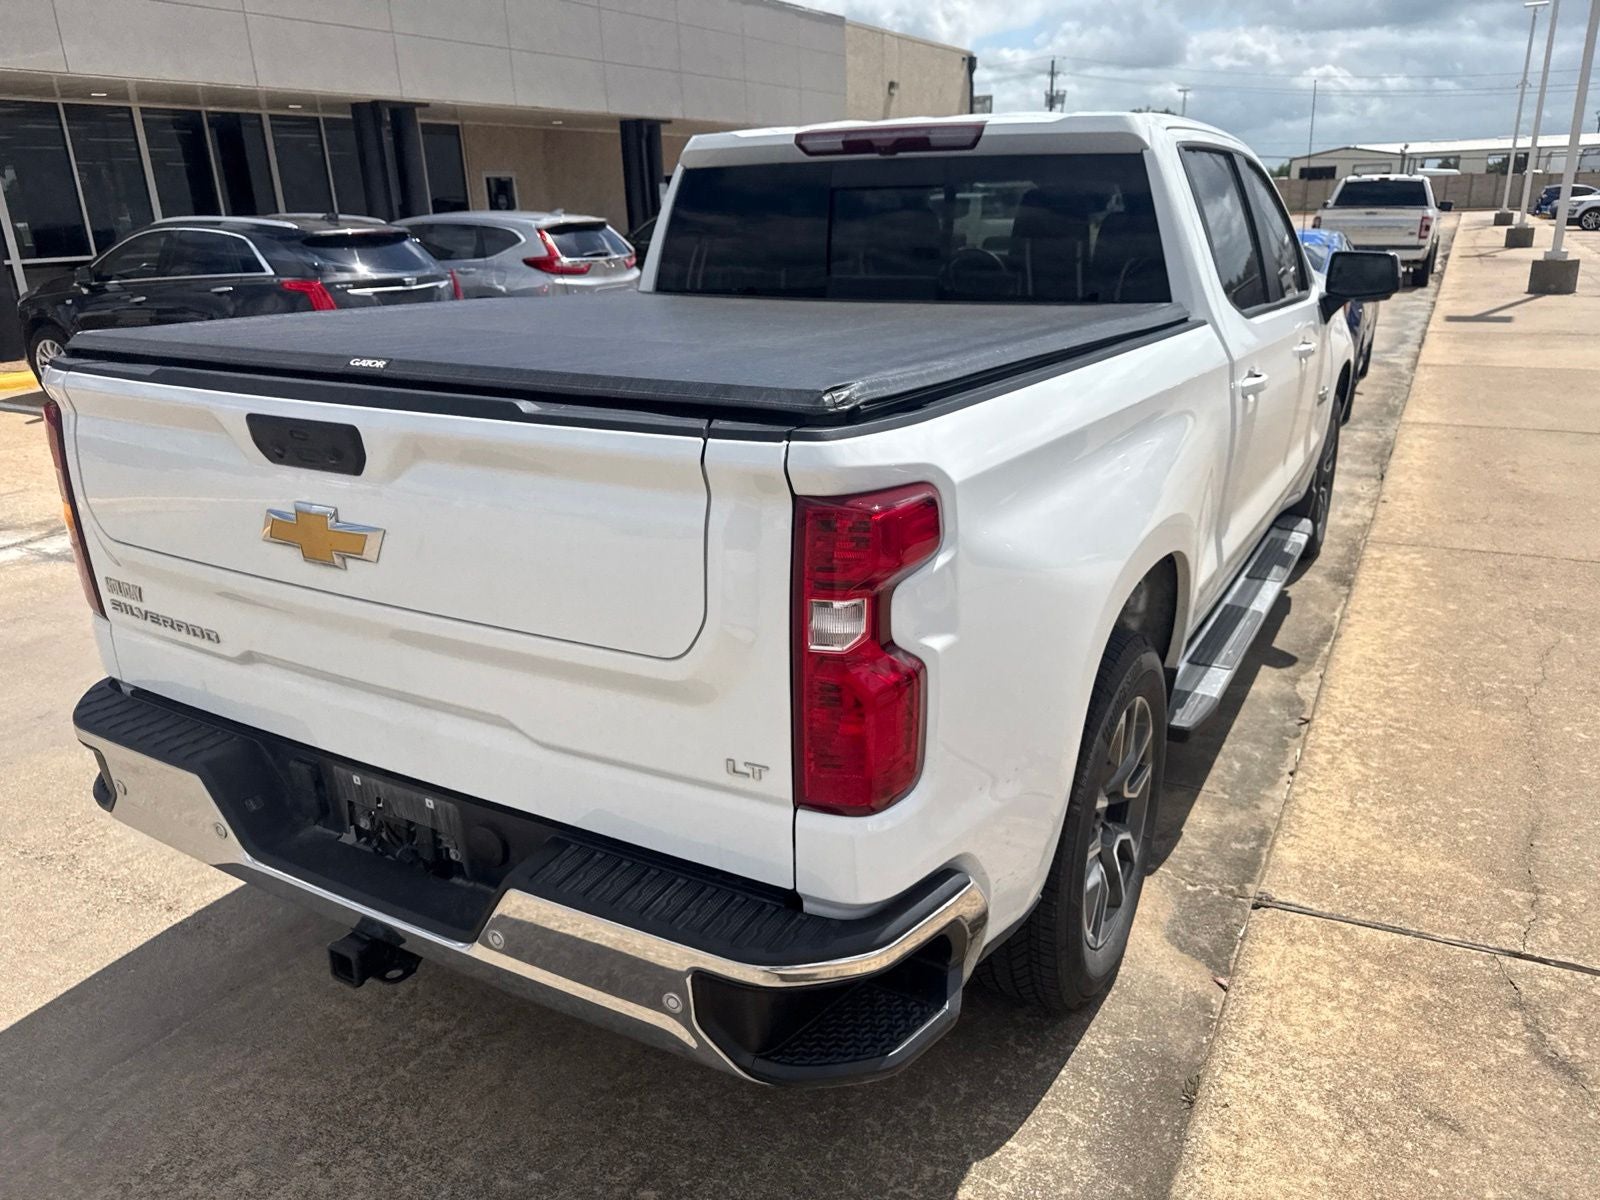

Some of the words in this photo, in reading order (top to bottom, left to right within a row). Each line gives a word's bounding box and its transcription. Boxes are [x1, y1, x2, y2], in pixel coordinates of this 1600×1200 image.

[350, 358, 387, 368] GATOR
[110, 598, 220, 644] SILVERADO
[726, 757, 770, 781] LT
